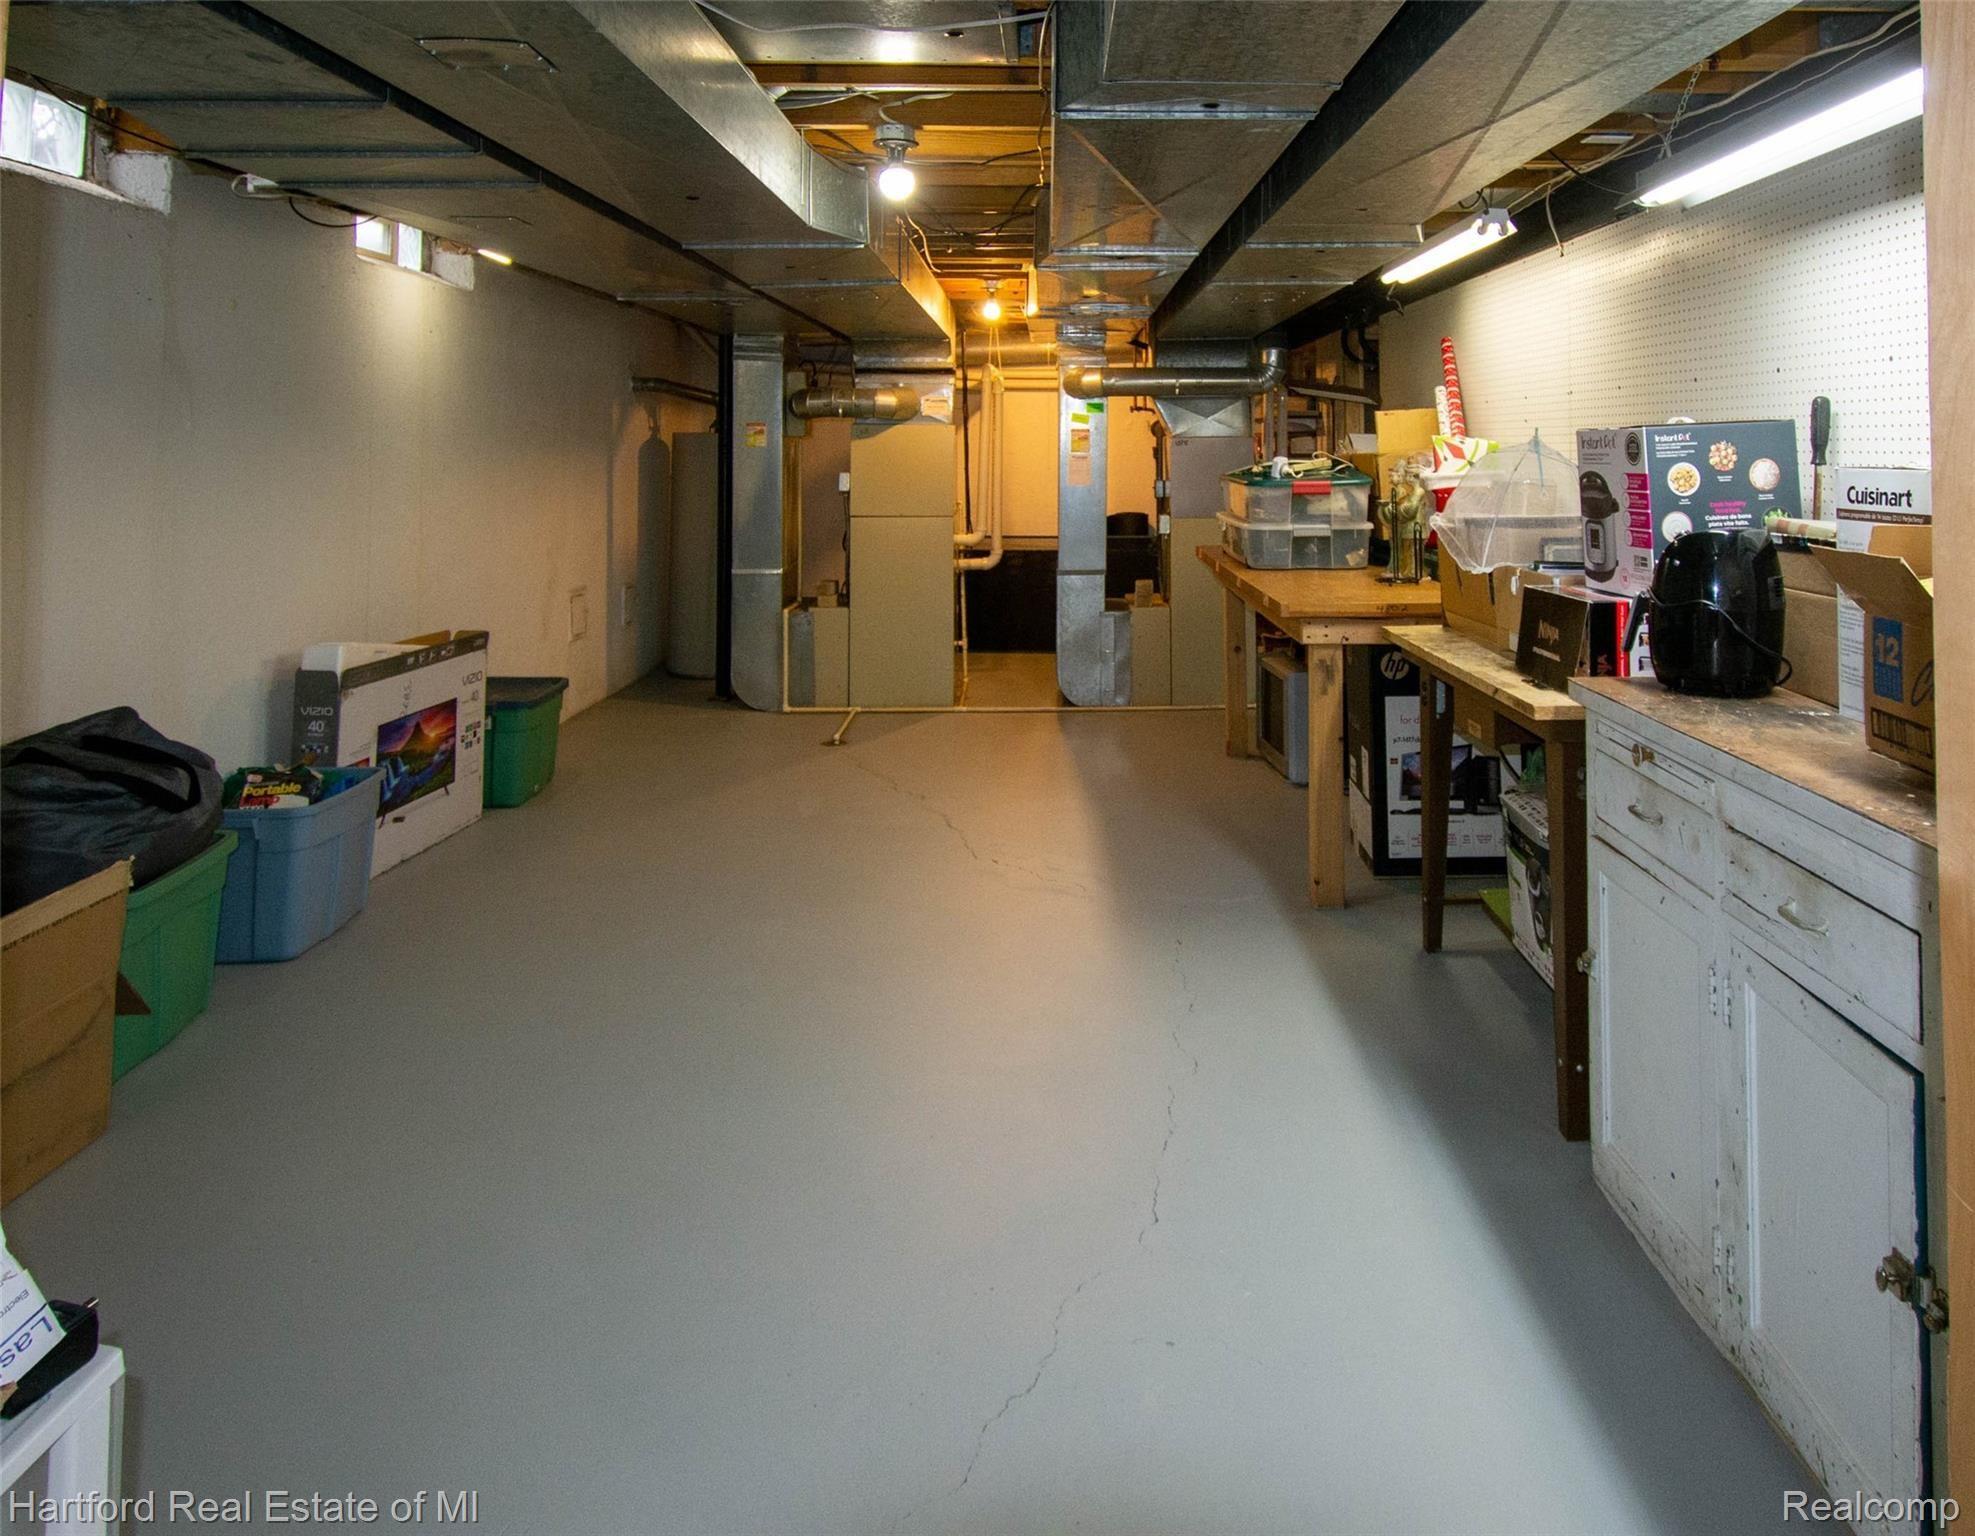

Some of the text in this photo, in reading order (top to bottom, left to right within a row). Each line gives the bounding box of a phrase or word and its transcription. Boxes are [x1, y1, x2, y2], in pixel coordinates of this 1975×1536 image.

[1846, 486, 1912, 508] Cuisinart
[1875, 632, 1900, 668] 12
[1383, 651, 1408, 680] hp
[300, 706, 335, 716] VIZIO
[307, 720, 325, 732] 40
[242, 782, 302, 797] Portable
[0, 1316, 53, 1374] Las
